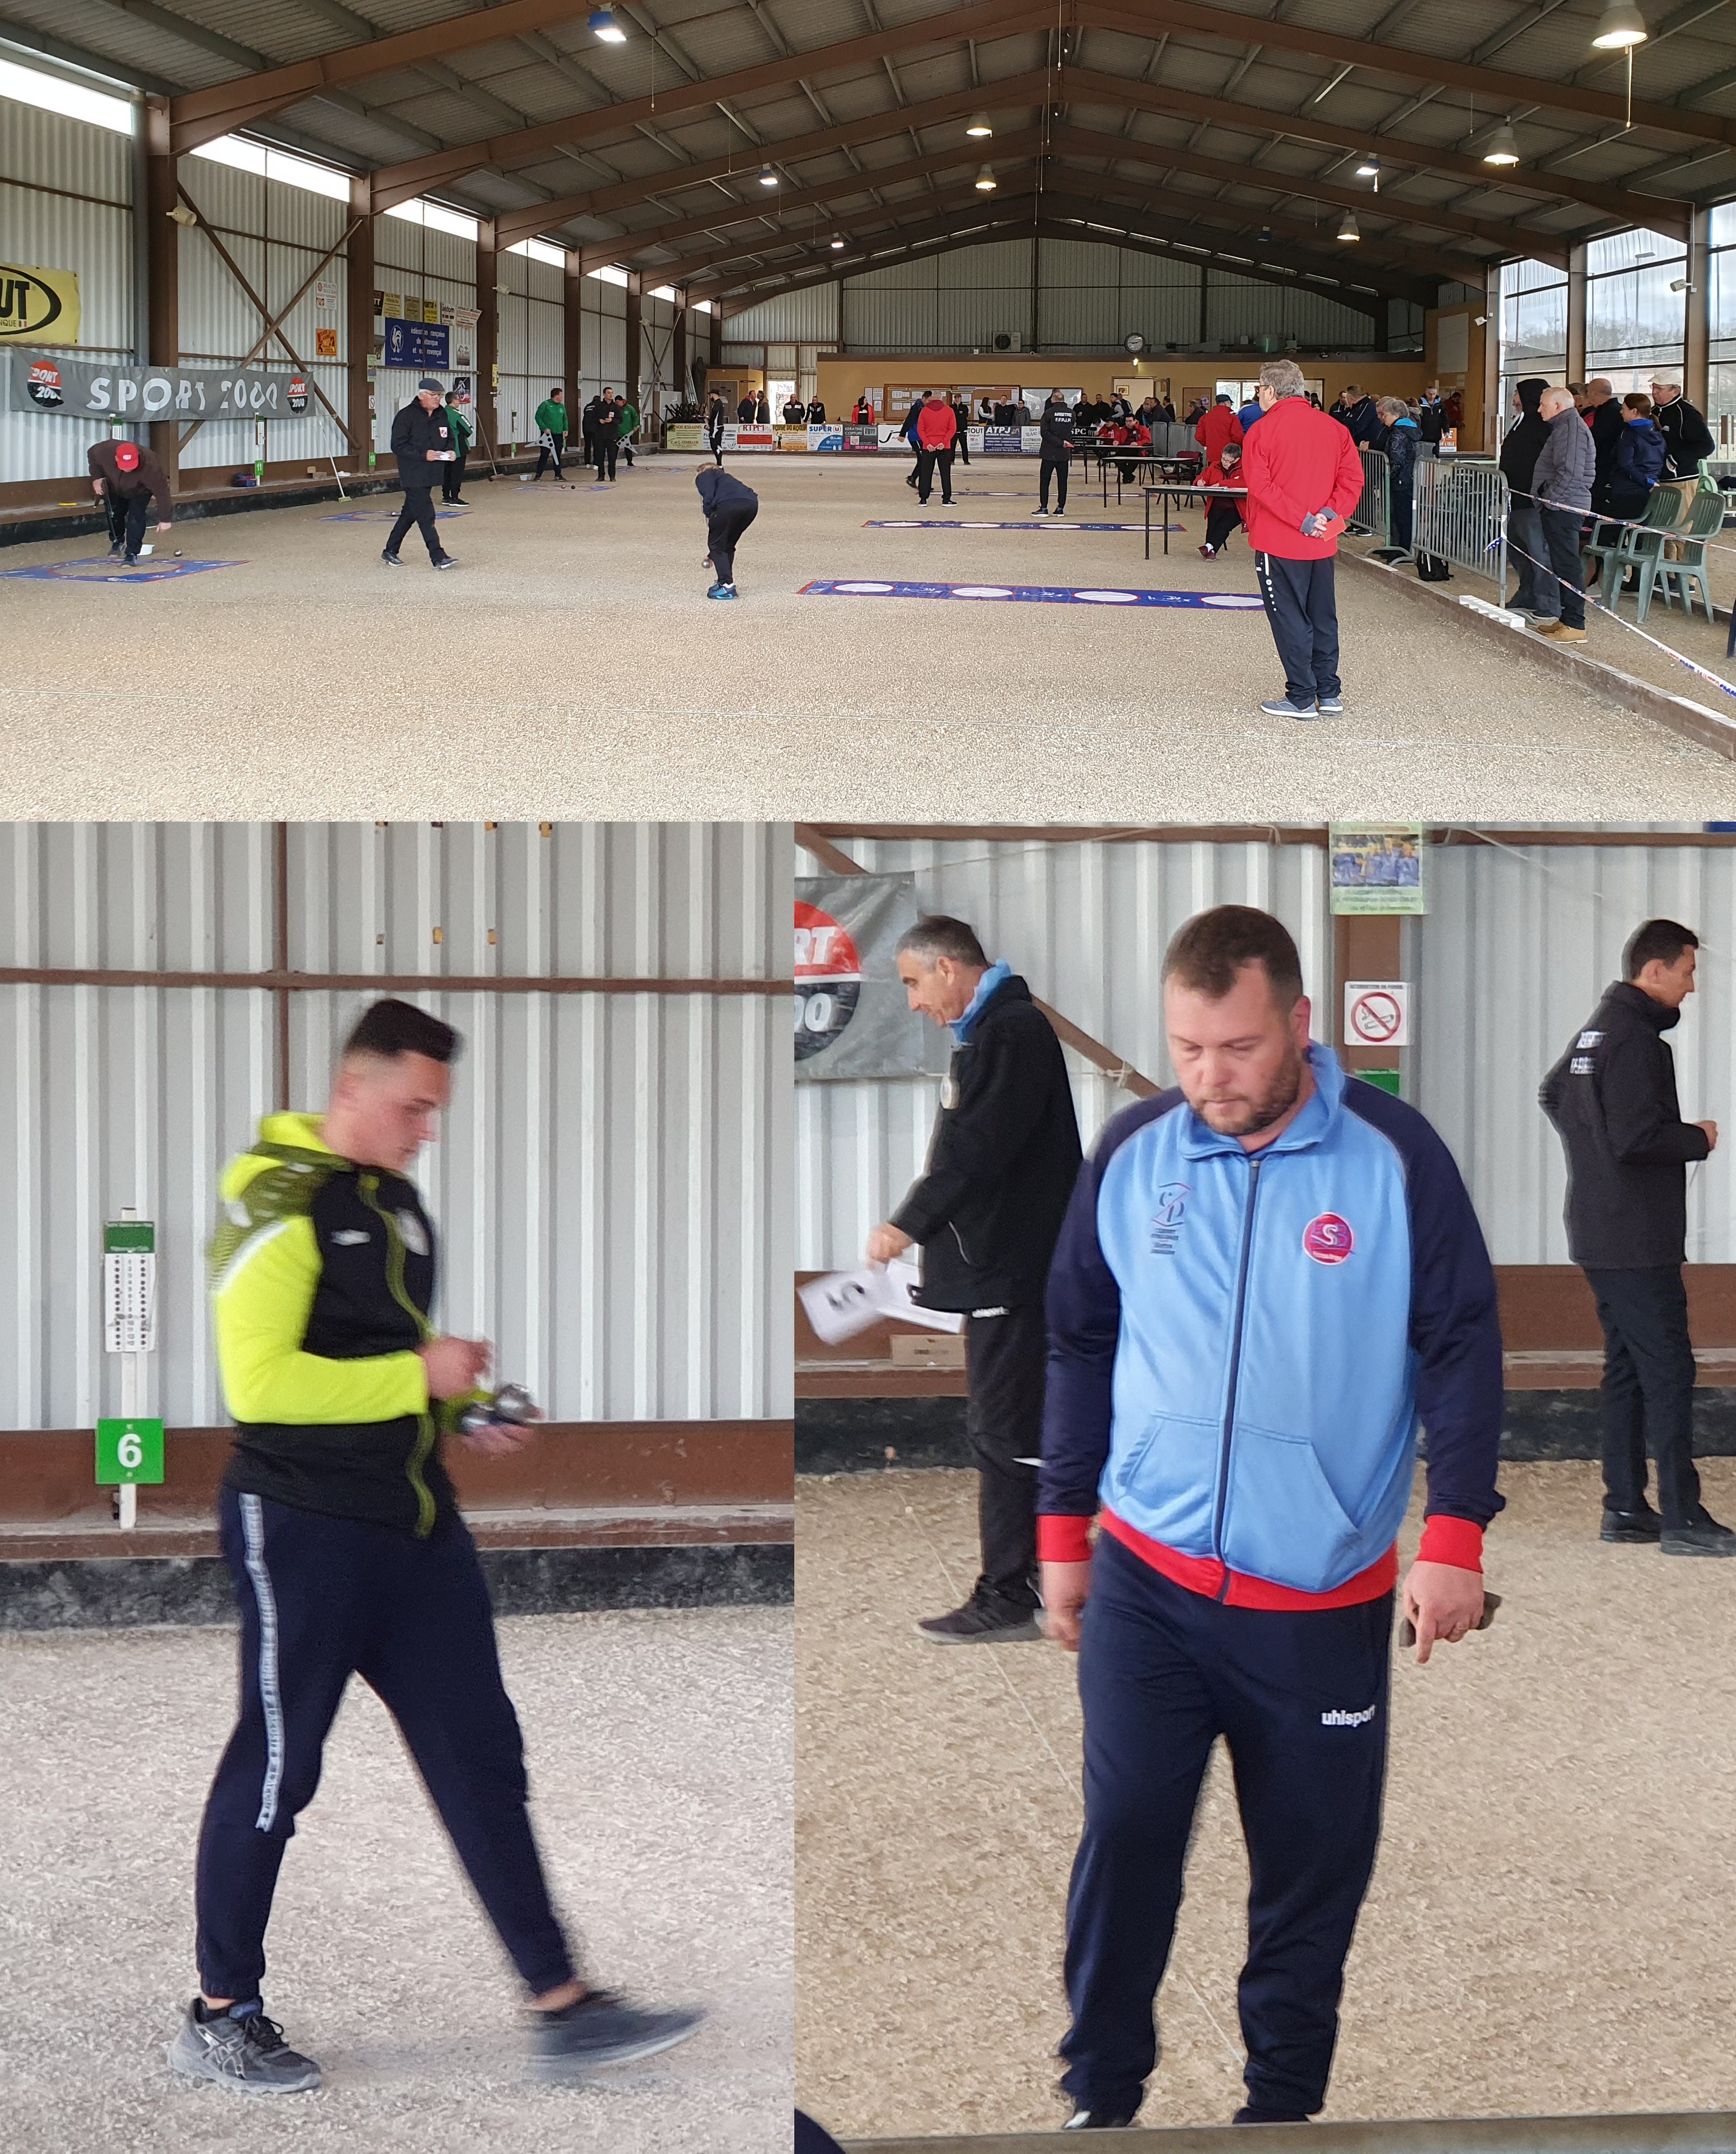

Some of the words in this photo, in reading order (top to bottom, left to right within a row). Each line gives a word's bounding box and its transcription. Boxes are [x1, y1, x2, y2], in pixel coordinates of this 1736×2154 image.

[86, 377, 206, 411] SPORT
[220, 379, 277, 410] 2000
[292, 398, 305, 408] 2000
[256, 462, 263, 471] 11
[117, 1433, 143, 1468] 6
